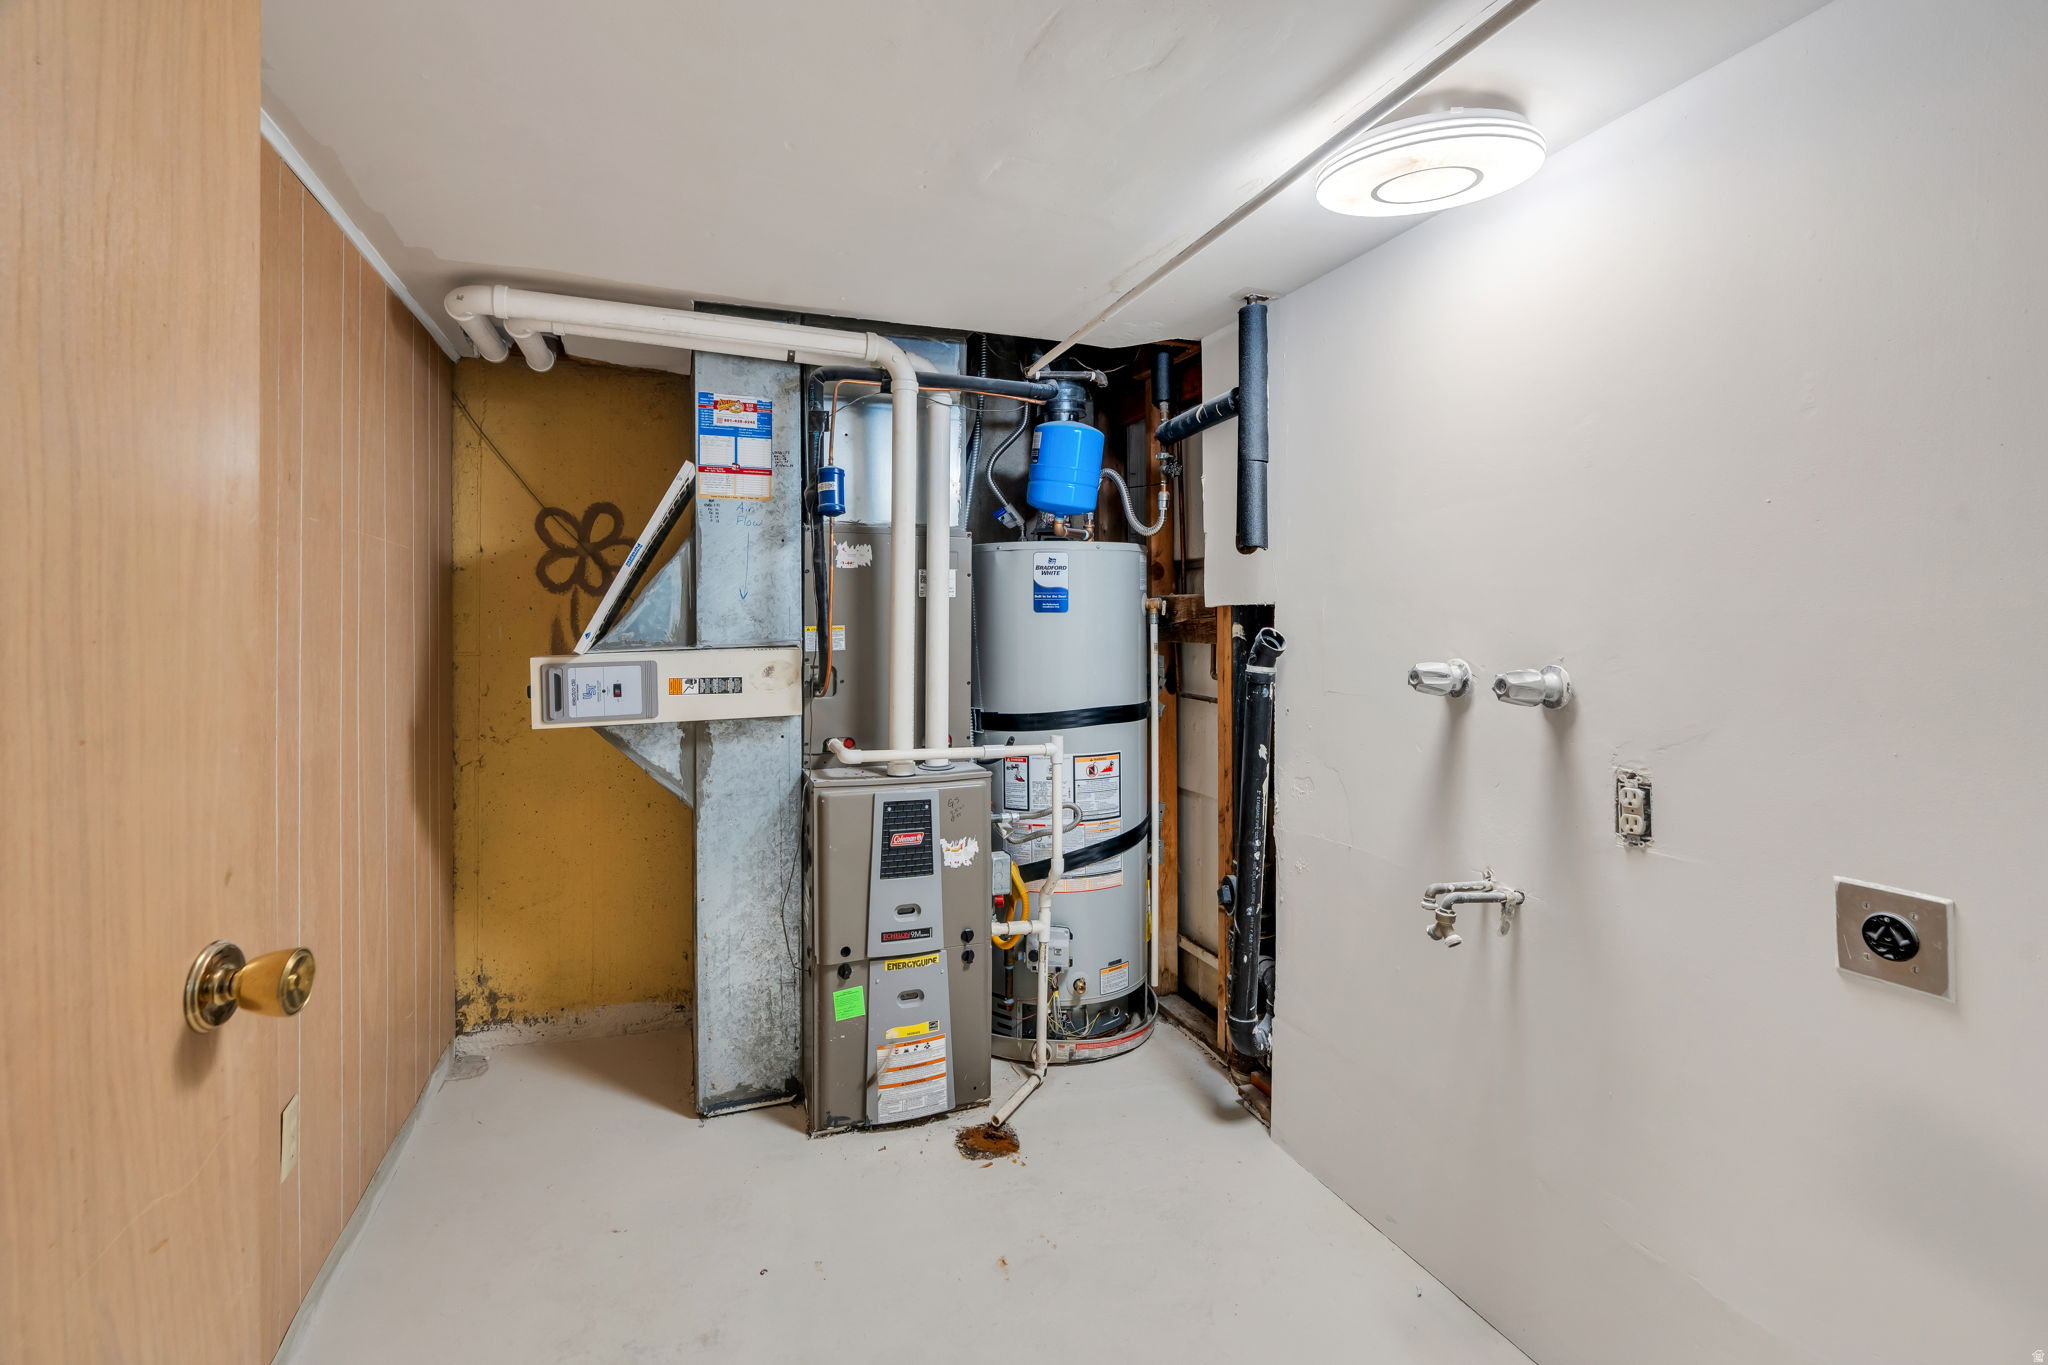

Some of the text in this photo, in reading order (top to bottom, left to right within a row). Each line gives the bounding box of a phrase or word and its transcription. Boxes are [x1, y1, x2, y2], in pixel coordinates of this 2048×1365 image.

[736, 514, 764, 527] Flow
[893, 834, 917, 844] Coleman
[886, 956, 939, 971] ENERGYGUIDE
